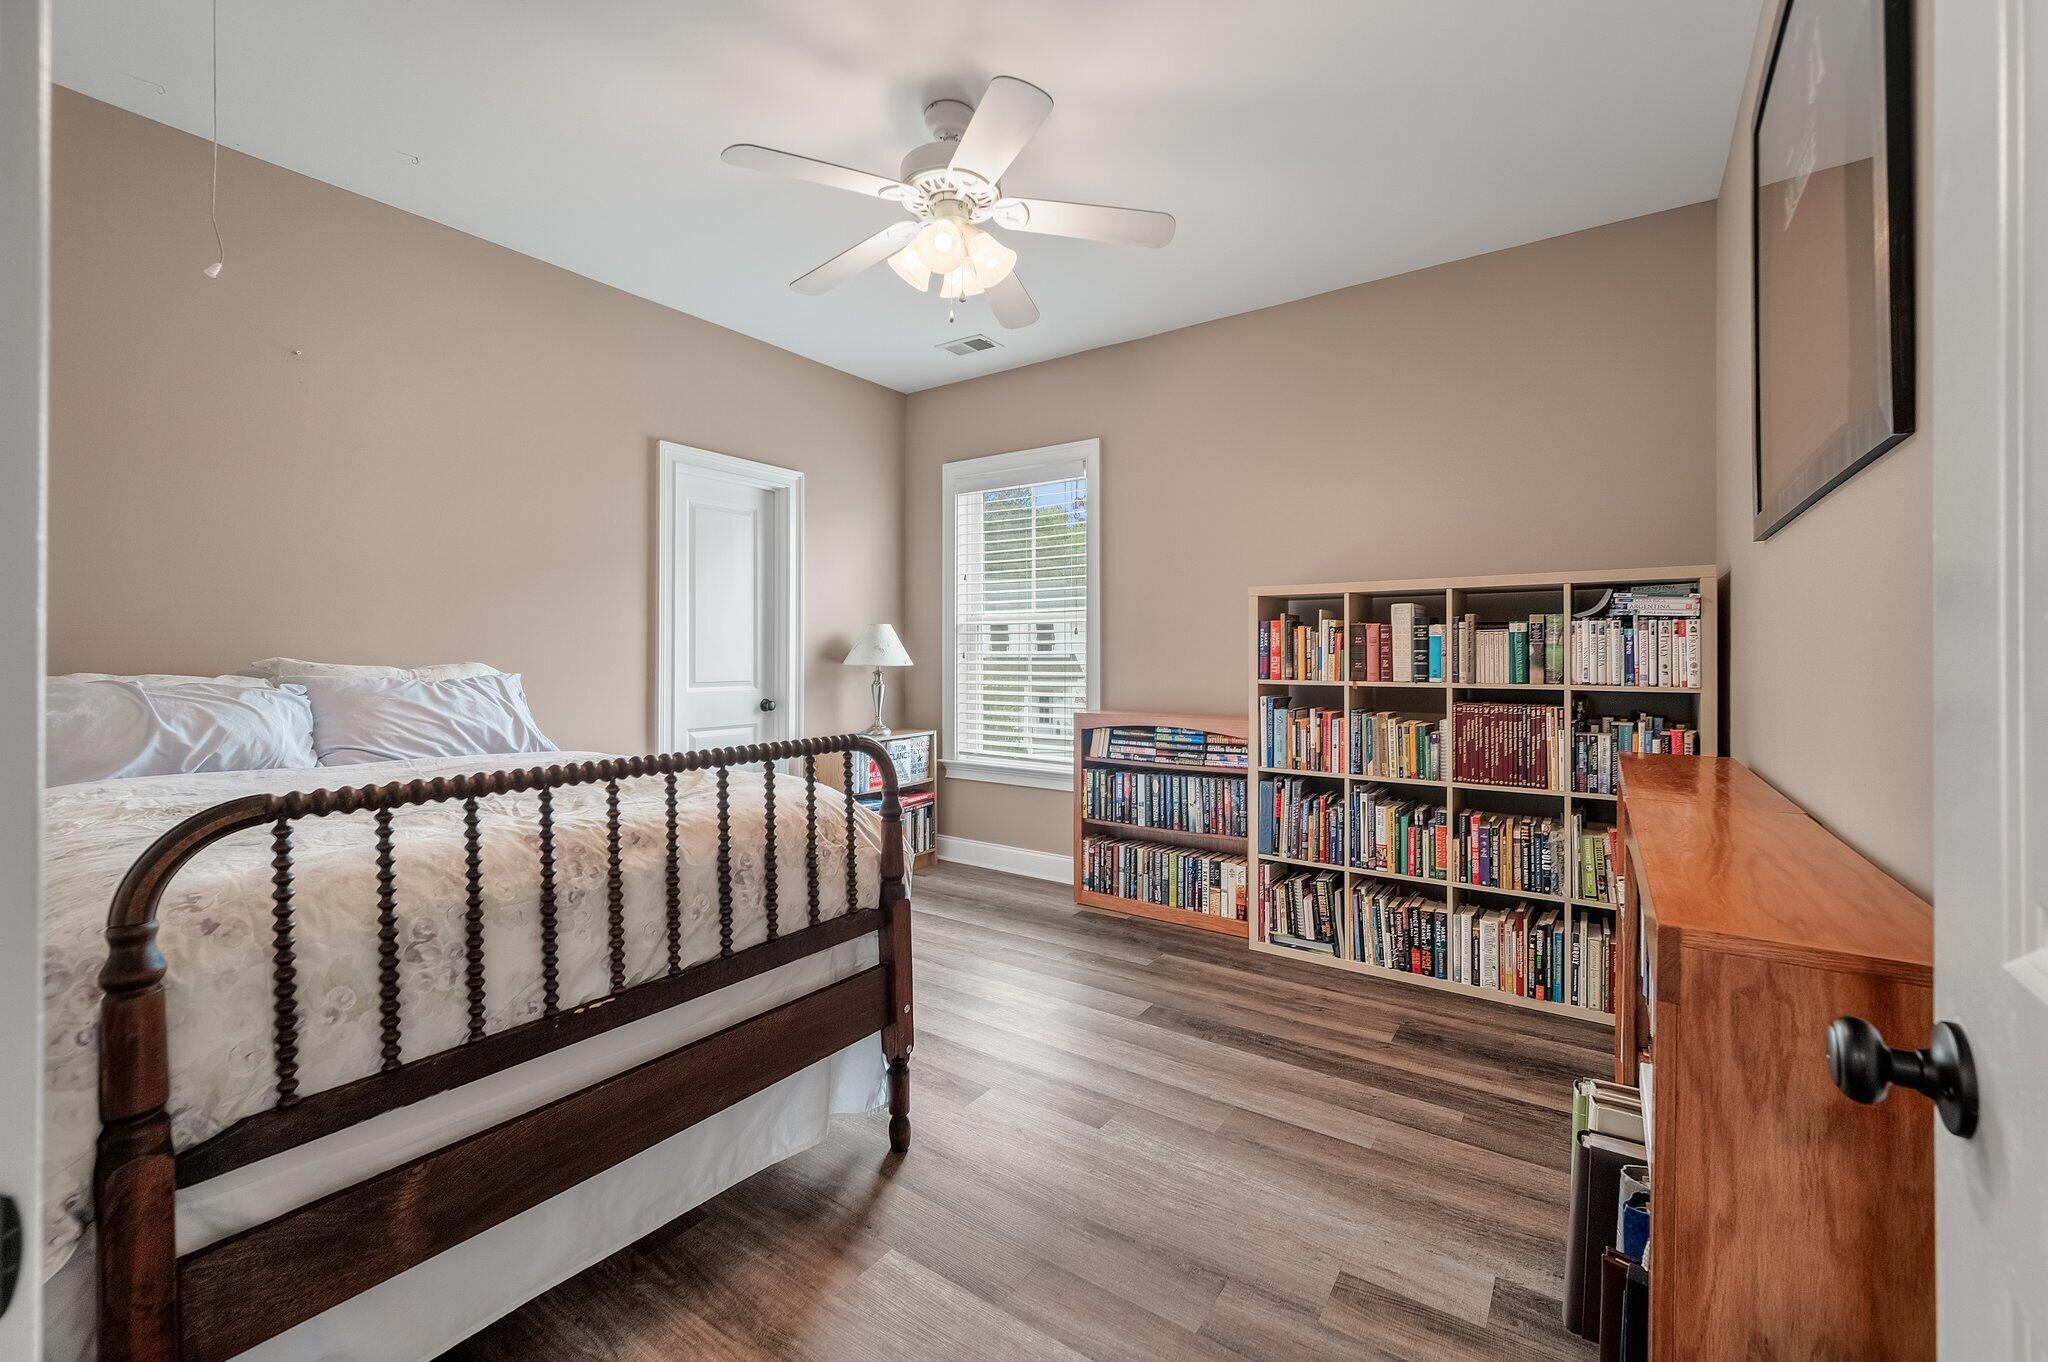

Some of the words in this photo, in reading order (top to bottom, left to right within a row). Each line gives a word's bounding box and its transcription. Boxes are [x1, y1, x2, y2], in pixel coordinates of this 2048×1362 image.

[1660, 636, 1669, 658] ITALY
[1688, 635, 1698, 661] FRANCE
[894, 744, 907, 752] TOM
[910, 740, 930, 749] VINCE
[1206, 735, 1229, 744] Griffin
[1542, 848, 1552, 870] SOLO
[1396, 914, 1404, 935] Oriental
[1411, 909, 1419, 926] VINCE
[1397, 936, 1405, 951] Rugs
[1412, 927, 1420, 946] FLYNN
